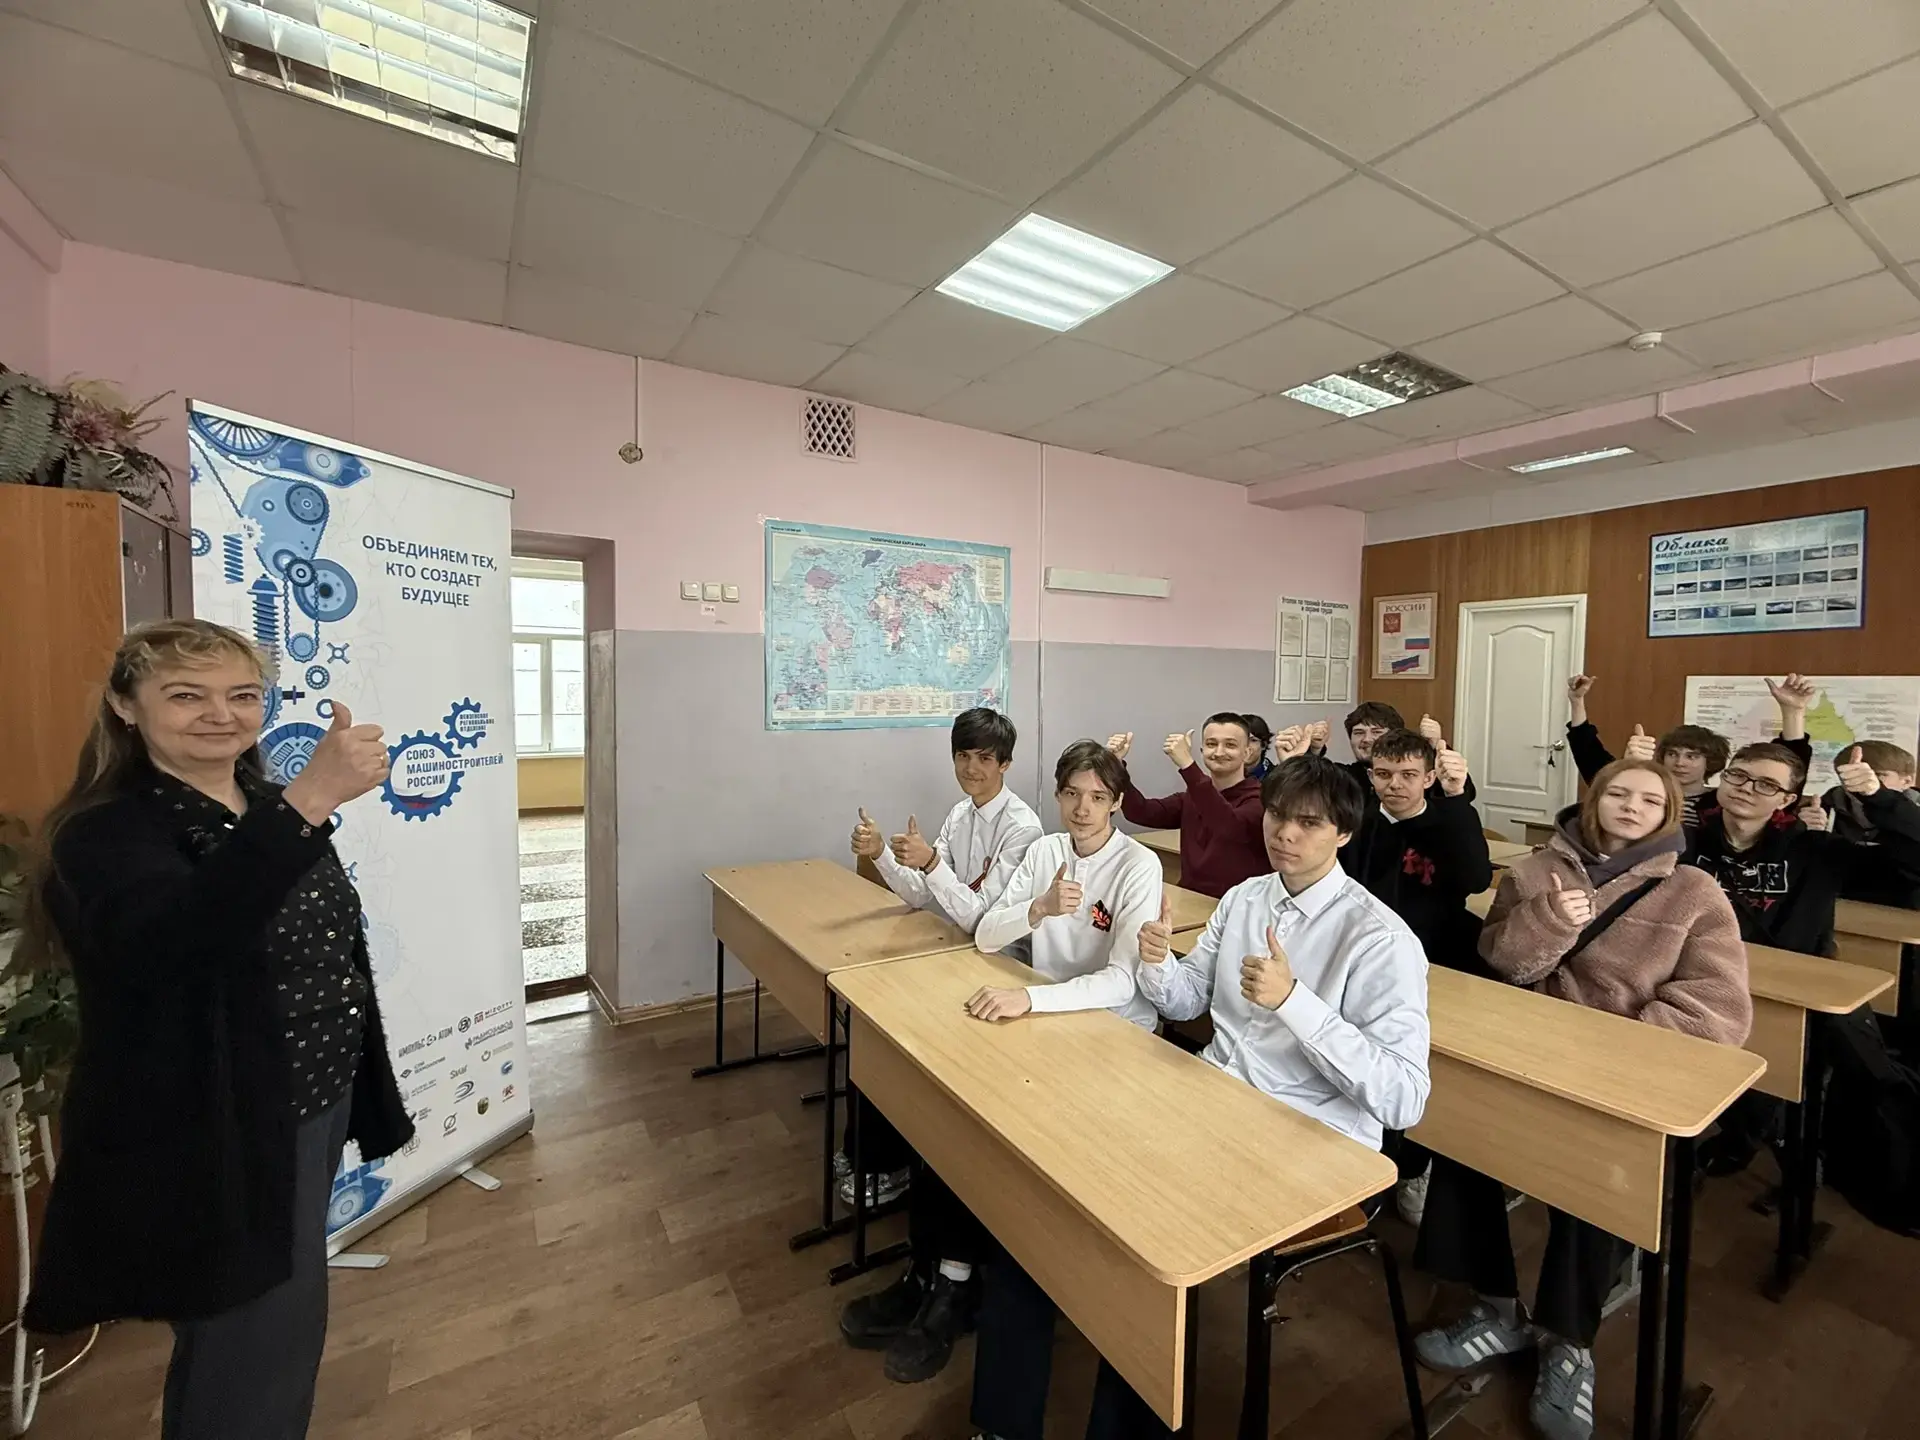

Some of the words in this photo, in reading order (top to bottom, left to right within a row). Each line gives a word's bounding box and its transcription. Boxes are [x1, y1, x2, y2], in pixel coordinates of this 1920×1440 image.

[362, 535, 468, 565] ОБЪЕДИНЯЕМ
[471, 554, 497, 571] ТЕХ,
[1655, 536, 1728, 552] Облака
[386, 562, 416, 578] КТО
[420, 567, 481, 587] СОЗДАЕТ
[402, 587, 470, 608] БУДУЩЕЕ
[1385, 603, 1426, 613] РОССИИ
[406, 749, 435, 760] СОЮЗ
[406, 753, 504, 775] МАШИНОСТРОИТЕЛЕЙ
[407, 774, 446, 788] РОССИИ
